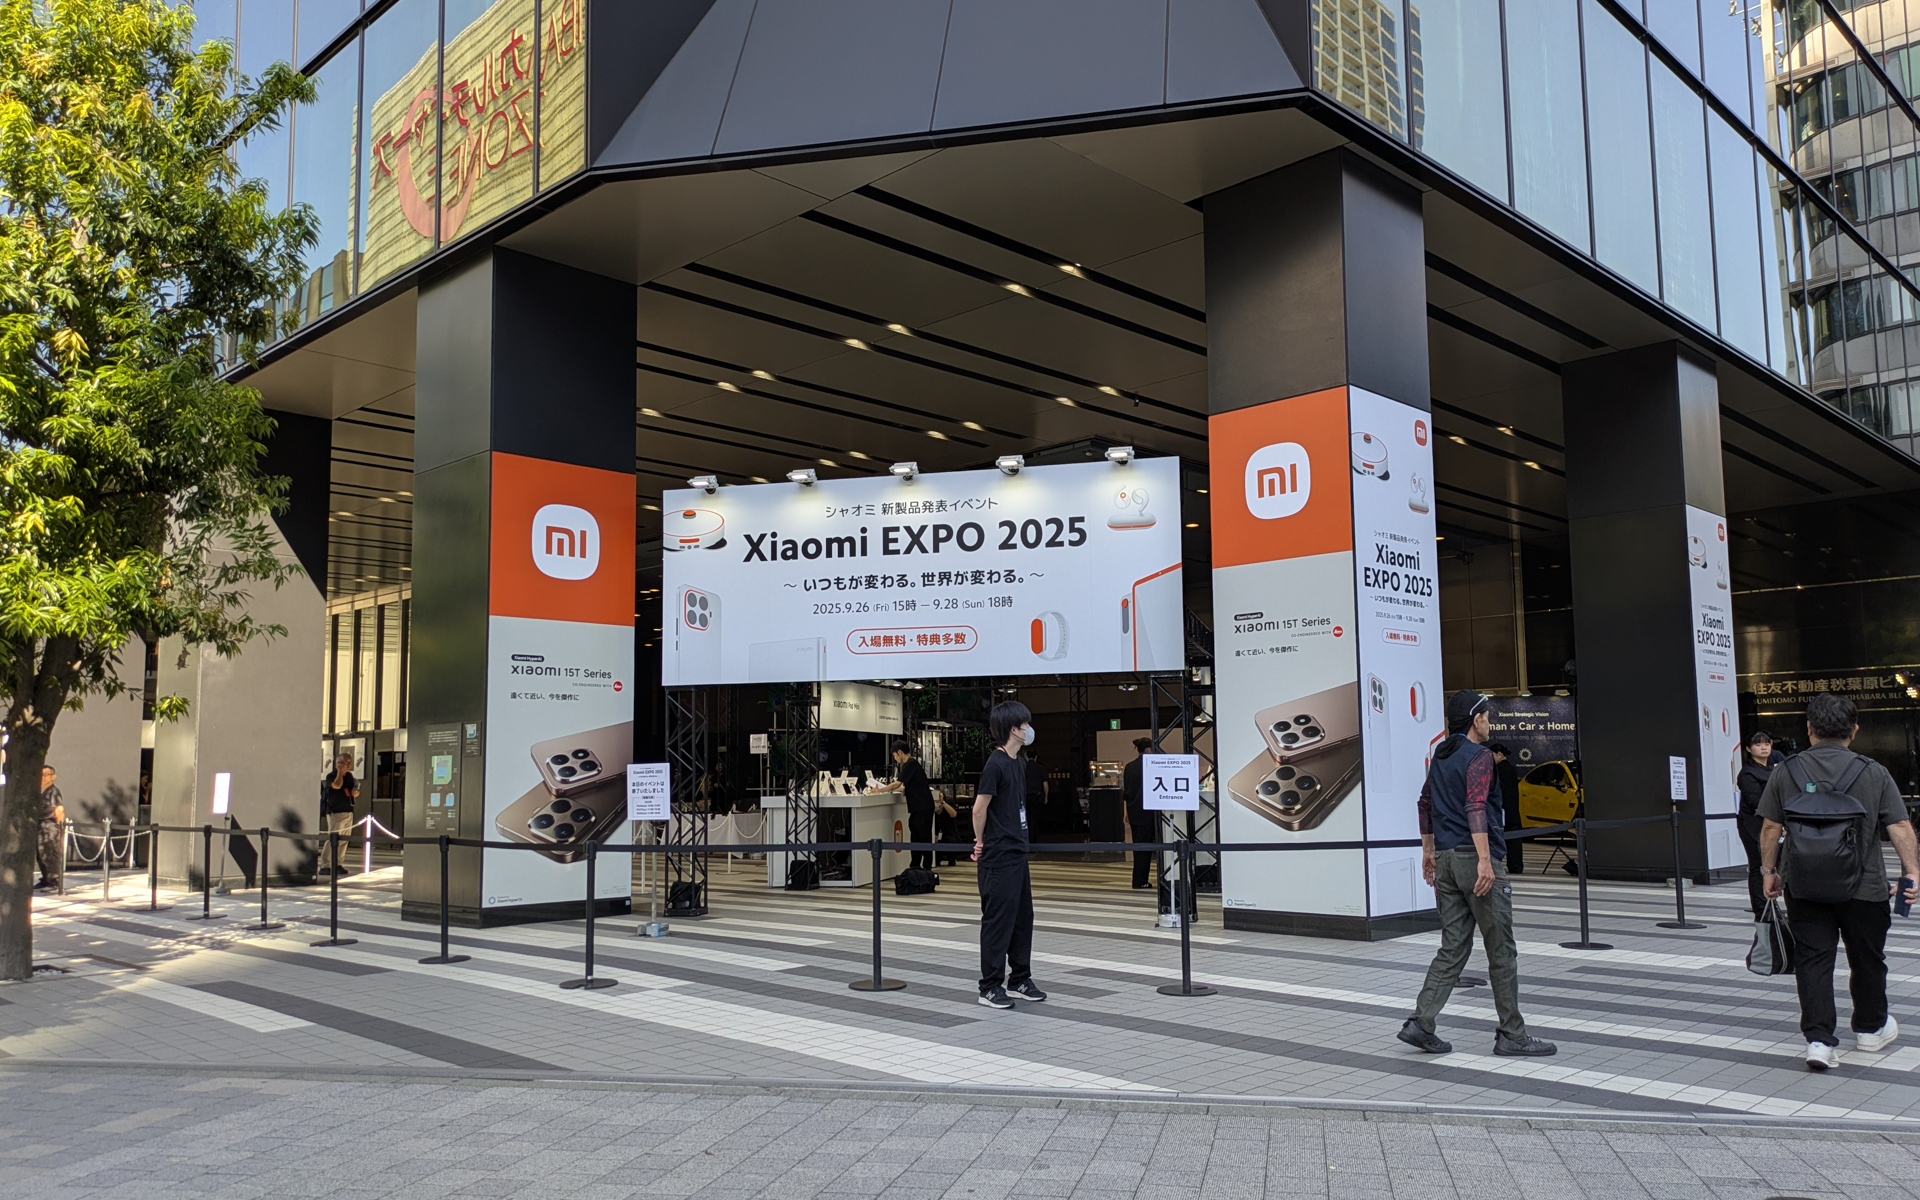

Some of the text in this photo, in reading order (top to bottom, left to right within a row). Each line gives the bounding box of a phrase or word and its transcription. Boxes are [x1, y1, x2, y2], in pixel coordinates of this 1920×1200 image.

[825, 497, 999, 519] シャオミ 新製品発表イベント
[742, 515, 1088, 563] Xiaomi EXPO 2025
[1375, 543, 1420, 571] Xiaomi
[1364, 566, 1432, 597] EXPO 2025
[813, 602, 870, 615] 2025.9.26
[893, 600, 917, 611] 15時
[933, 598, 958, 610] 9.28
[987, 596, 1013, 608] 18時
[1282, 619, 1298, 629] 15T
[1301, 616, 1331, 628] Series
[1702, 613, 1724, 630] Xiaomi
[858, 632, 966, 648] 入場無料・特典多数
[1697, 629, 1731, 649] EXPO 2025
[564, 668, 580, 677] 15T
[584, 668, 612, 679] Series
[1753, 697, 1796, 705] SUMITOMO
[1489, 723, 1507, 731] man
[1518, 721, 1535, 731] Car
[1547, 721, 1576, 731] Home
[1152, 776, 1189, 792] 入口
